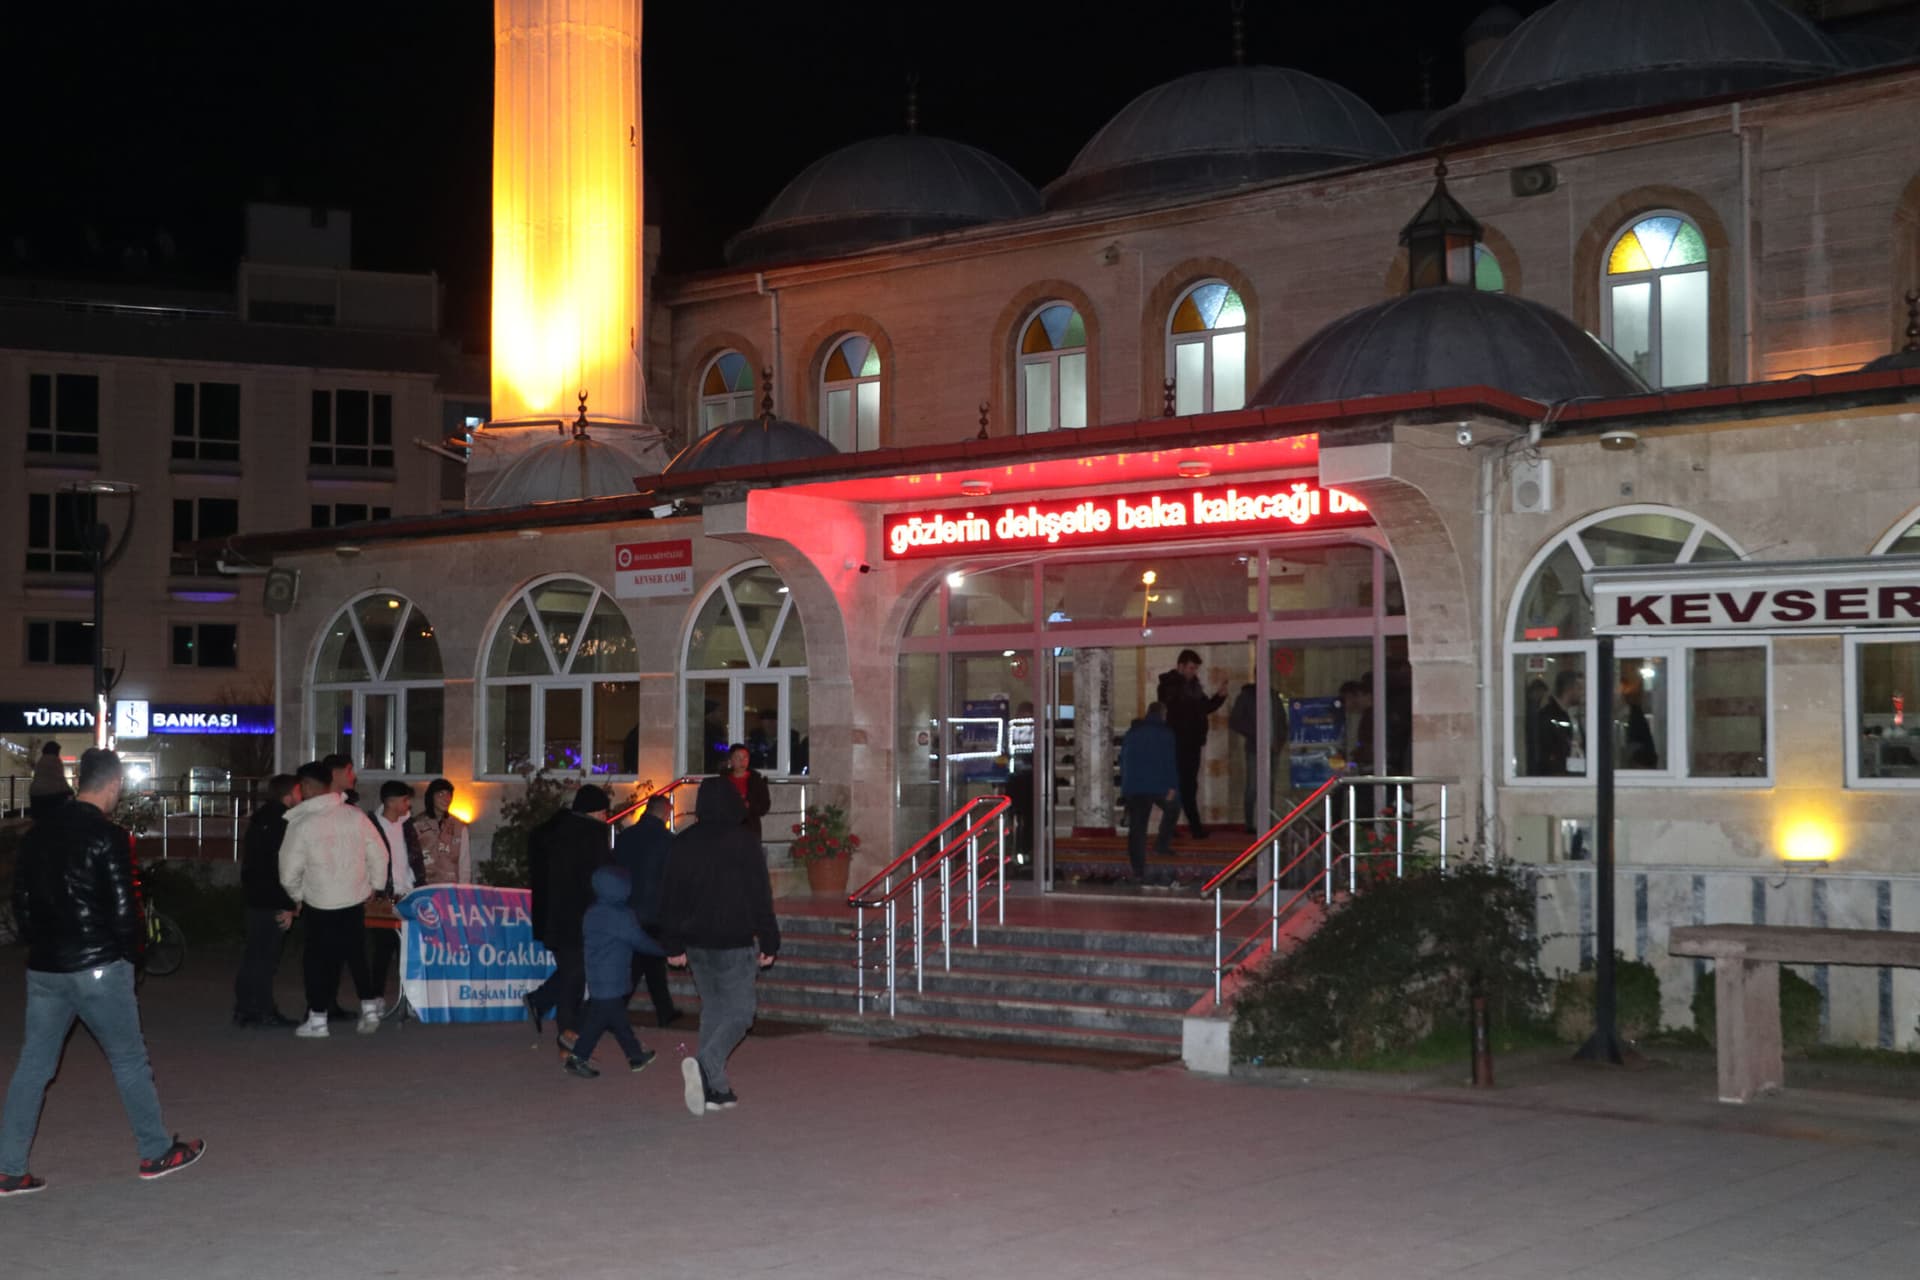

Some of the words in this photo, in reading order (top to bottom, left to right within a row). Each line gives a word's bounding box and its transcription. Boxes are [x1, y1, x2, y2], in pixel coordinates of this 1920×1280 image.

[1117, 496, 1186, 530] baka
[1193, 483, 1320, 524] kalacağı
[1616, 586, 1920, 626] KEVSER
[152, 712, 238, 728] BANKASI
[448, 904, 532, 927] HAVZA
